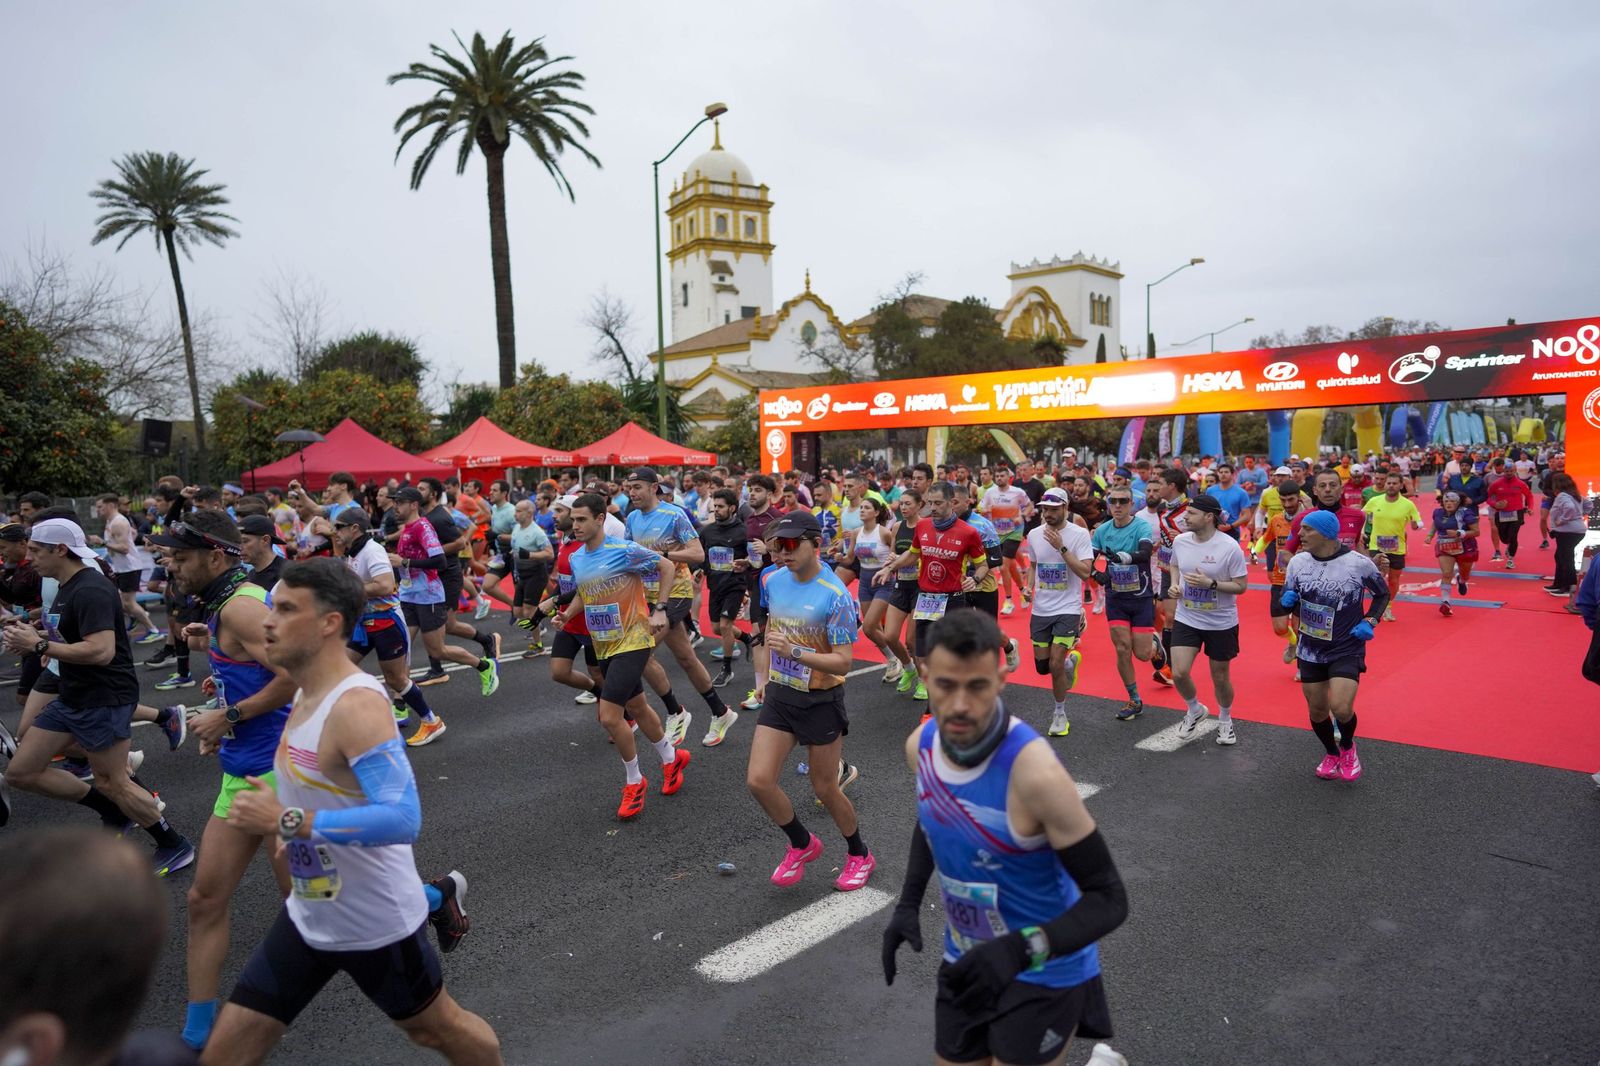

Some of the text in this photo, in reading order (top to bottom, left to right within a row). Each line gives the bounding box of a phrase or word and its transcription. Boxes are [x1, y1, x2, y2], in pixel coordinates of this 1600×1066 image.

[1445, 354, 1526, 371] Sprinter
[1532, 369, 1597, 380] AYUNTAMIENTO
[1182, 370, 1245, 393] HOKA
[1256, 380, 1305, 392] HYUNDAI
[904, 393, 948, 411] HOKA
[1041, 569, 1060, 579] 3675
[1188, 586, 1210, 598] 3677
[1298, 580, 1347, 593] FURIOX
[920, 600, 939, 609] 3579
[589, 613, 611, 626] 3670
